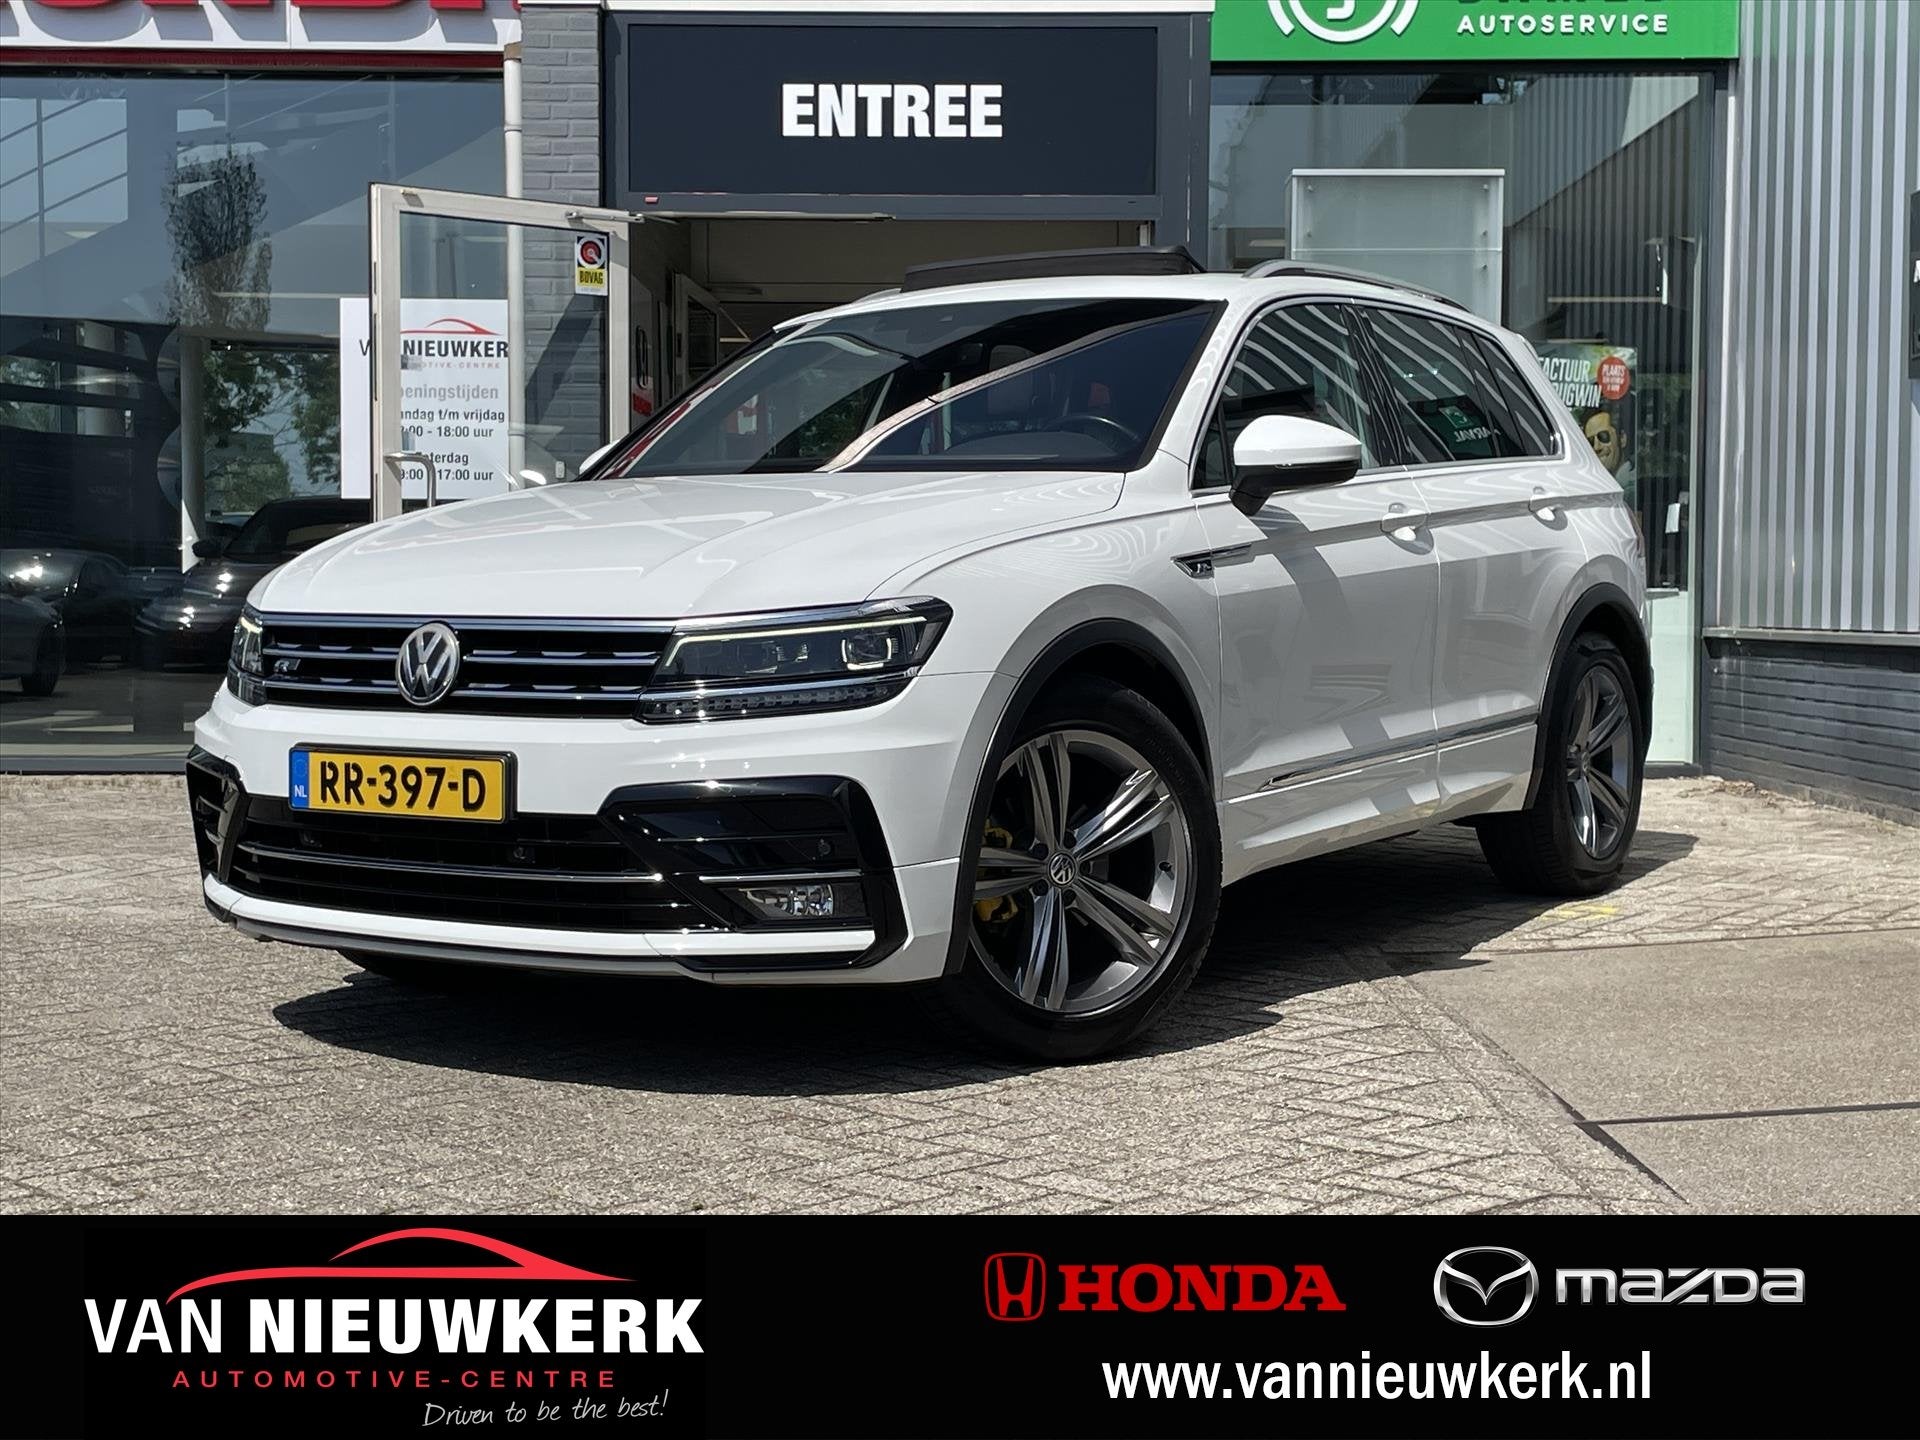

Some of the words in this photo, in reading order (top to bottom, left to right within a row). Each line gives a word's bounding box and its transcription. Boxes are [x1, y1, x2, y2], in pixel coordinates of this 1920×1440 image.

[1457, 14, 1668, 33] AUTOSERVICE
[782, 83, 1003, 138] ENTREE
[579, 270, 604, 285] BOVAG
[402, 340, 509, 358] NIEUWKER
[1538, 356, 1591, 383] ACTUUR
[400, 383, 499, 402] eningstijden
[438, 409, 460, 420] t/m
[463, 409, 505, 423] vrijdag
[436, 425, 470, 438] 18:00
[473, 428, 494, 438] uur
[437, 468, 470, 481] 17:00
[473, 471, 494, 481] uur
[294, 784, 308, 798] NL
[320, 760, 486, 813] RR-397-D
